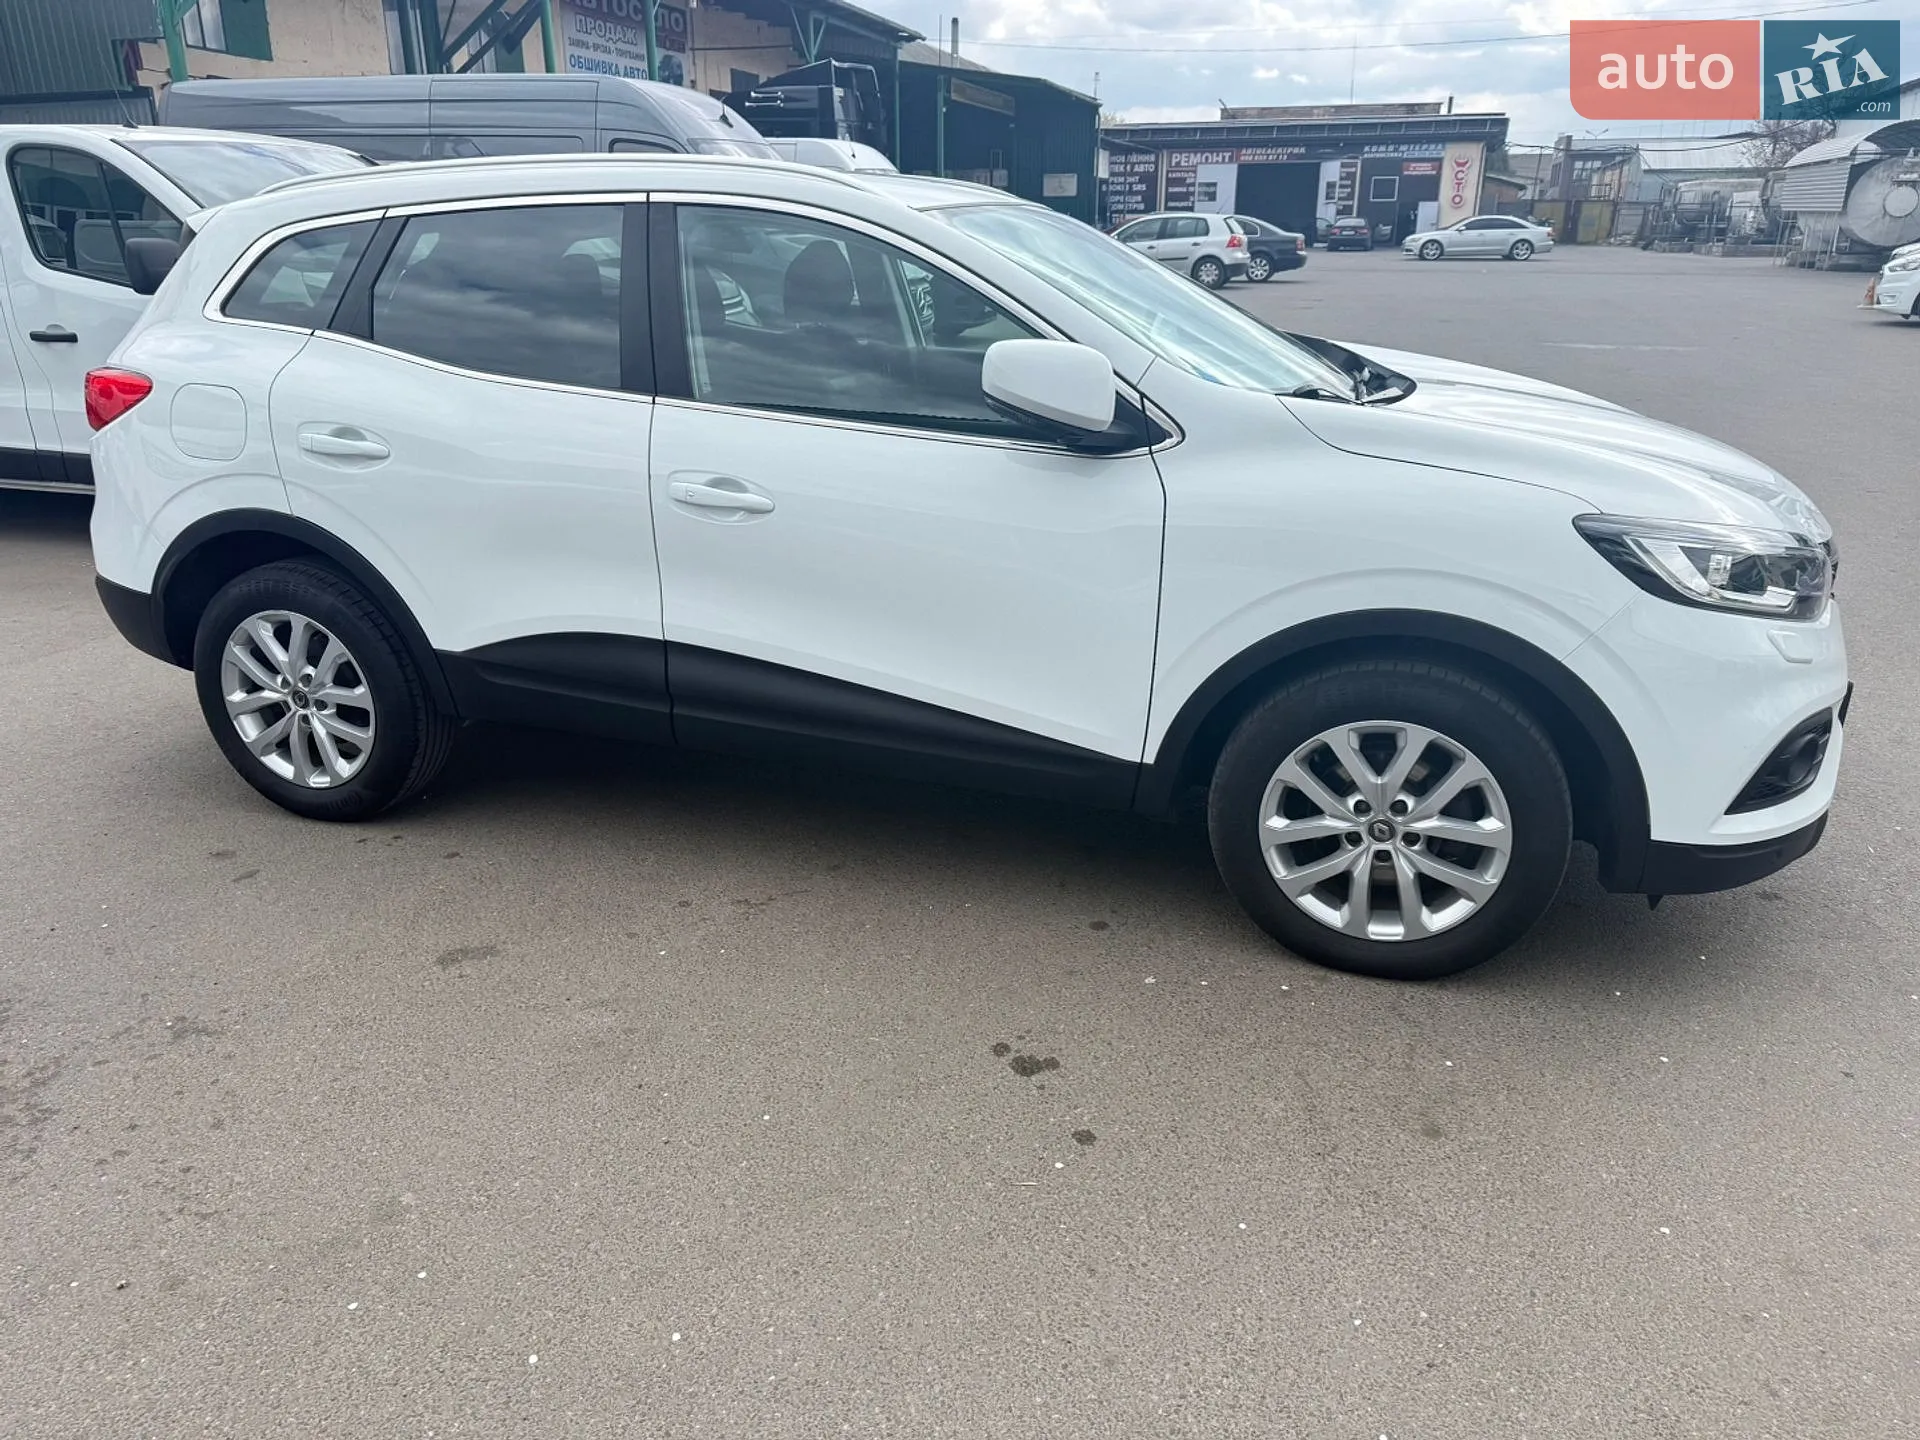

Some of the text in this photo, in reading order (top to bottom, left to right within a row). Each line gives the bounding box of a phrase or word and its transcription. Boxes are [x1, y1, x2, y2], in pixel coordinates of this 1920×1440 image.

[569, 54, 648, 80] ОБШИВКА АВТО
[1171, 151, 1232, 167] РЕМОНТ
[1452, 170, 1466, 205] СТО
